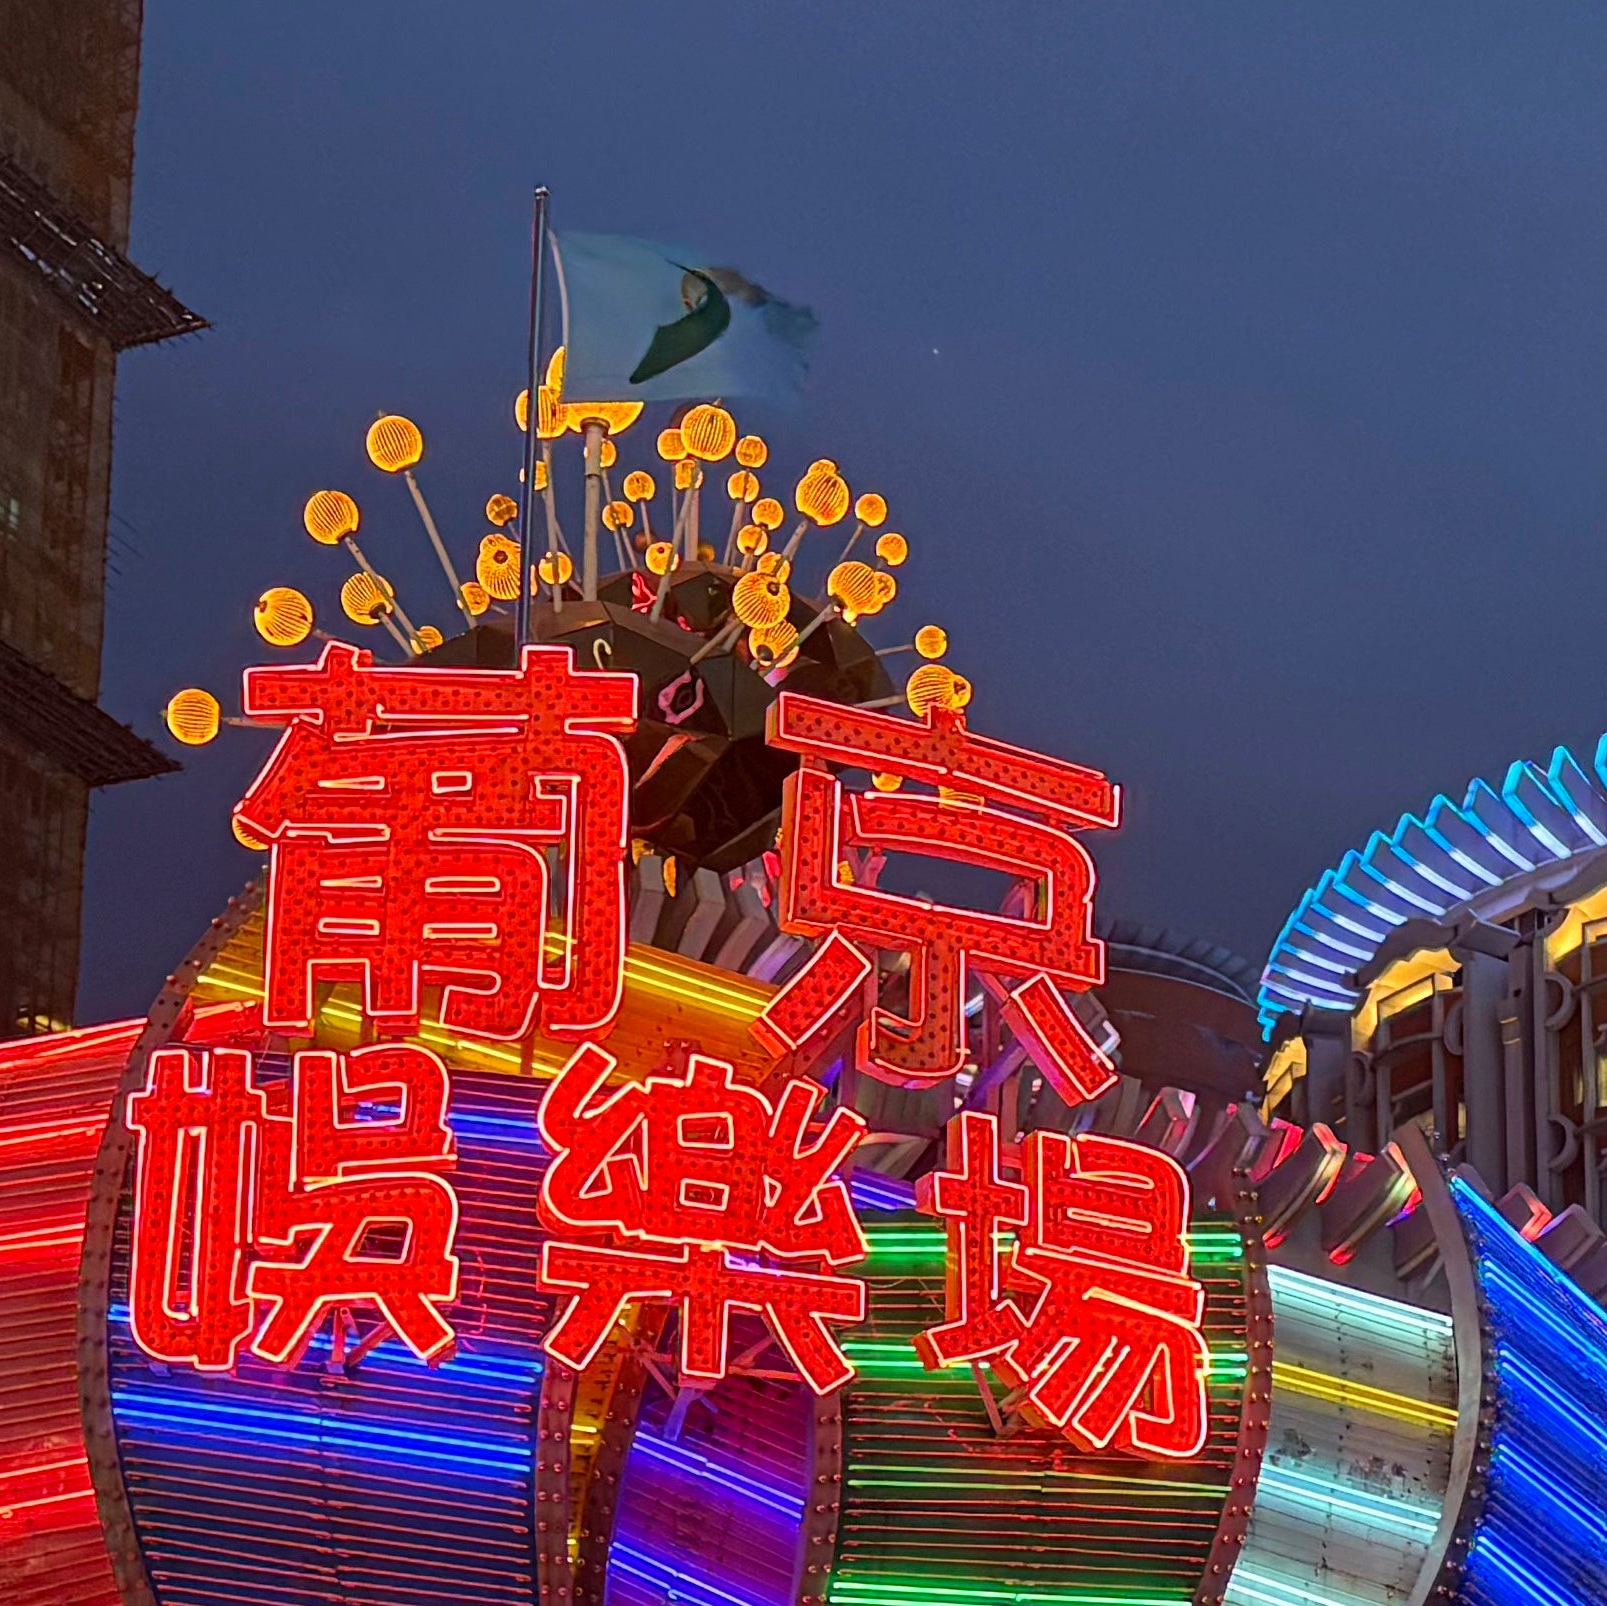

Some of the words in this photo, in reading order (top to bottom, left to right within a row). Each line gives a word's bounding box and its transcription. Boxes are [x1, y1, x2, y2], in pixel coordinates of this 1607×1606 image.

[232, 640, 1123, 1106] 葡京
[126, 1040, 1209, 1460] 娛樂場
